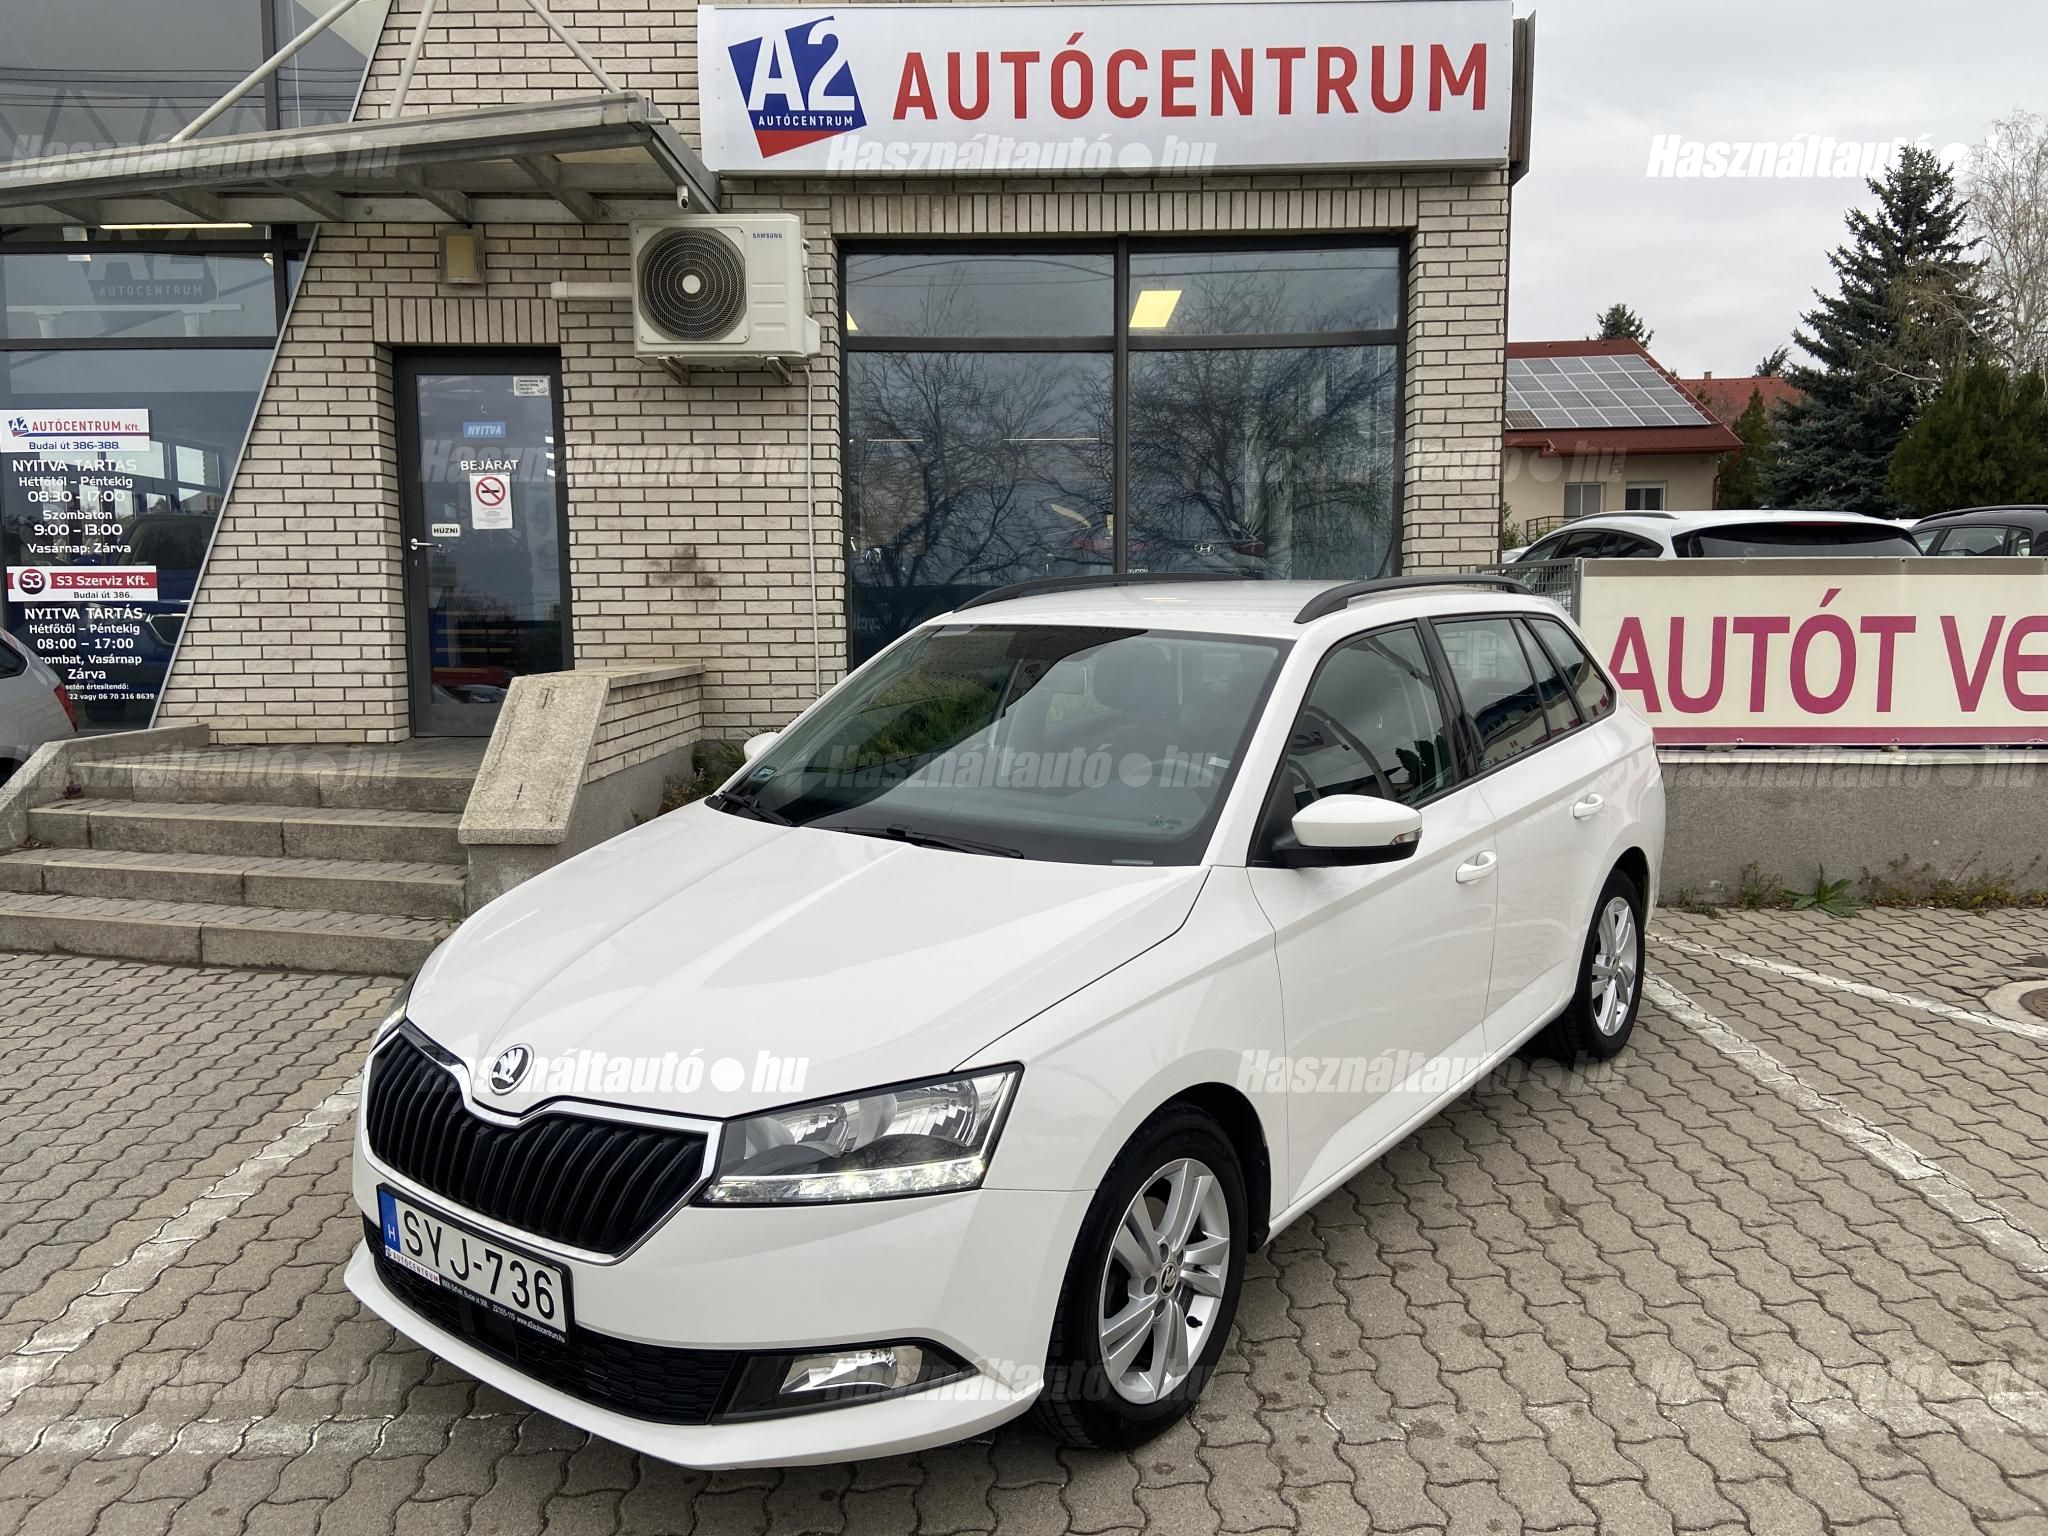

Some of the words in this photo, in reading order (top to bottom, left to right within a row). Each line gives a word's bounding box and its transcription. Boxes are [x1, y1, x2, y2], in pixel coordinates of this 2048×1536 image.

[748, 18, 855, 111] A2
[893, 32, 1487, 120] AUTÓCENTRUM
[758, 113, 853, 126] AUTÓCENTRUM
[752, 232, 784, 240] SAMSUNG
[32, 418, 121, 431] AUTÓCENTRUM
[125, 423, 141, 431] Kft.
[468, 425, 502, 435] NYITVA
[29, 441, 57, 450] Budai
[60, 441, 71, 450] út
[73, 441, 119, 450] 386-388
[12, 459, 68, 472] NYITVA
[76, 458, 137, 472] TARTÁS
[460, 457, 519, 471] BEJÁRAT
[19, 476, 67, 487] Hétfőtől
[81, 476, 133, 488] Péntekig
[28, 491, 72, 502] 08:30
[88, 491, 125, 502] 17:00
[43, 510, 113, 520] Szombaton
[34, 524, 69, 536] 9:00
[85, 524, 123, 536] 13:00
[27, 543, 90, 555] Vasárnap:
[94, 542, 132, 553] Zárva
[56, 576, 73, 586] S3
[76, 576, 122, 586] Szerviz
[127, 576, 149, 586] Kft.
[73, 591, 98, 599] Budai
[101, 591, 110, 599] út
[113, 591, 133, 599] 386.
[25, 608, 80, 620] NYITVA
[86, 604, 143, 620] TARTÁS
[29, 624, 75, 634] Hétfőtől
[90, 624, 140, 635] Péntekig
[37, 638, 76, 649] 08:00
[94, 638, 134, 649] 17:00
[1610, 588, 1916, 714] AUTÓT
[40, 654, 84, 665] ombat,
[88, 653, 142, 666] Vasárnap
[67, 667, 106, 680] Zárva
[387, 1223, 396, 1242] H
[403, 1210, 555, 1320] SYJ-736
